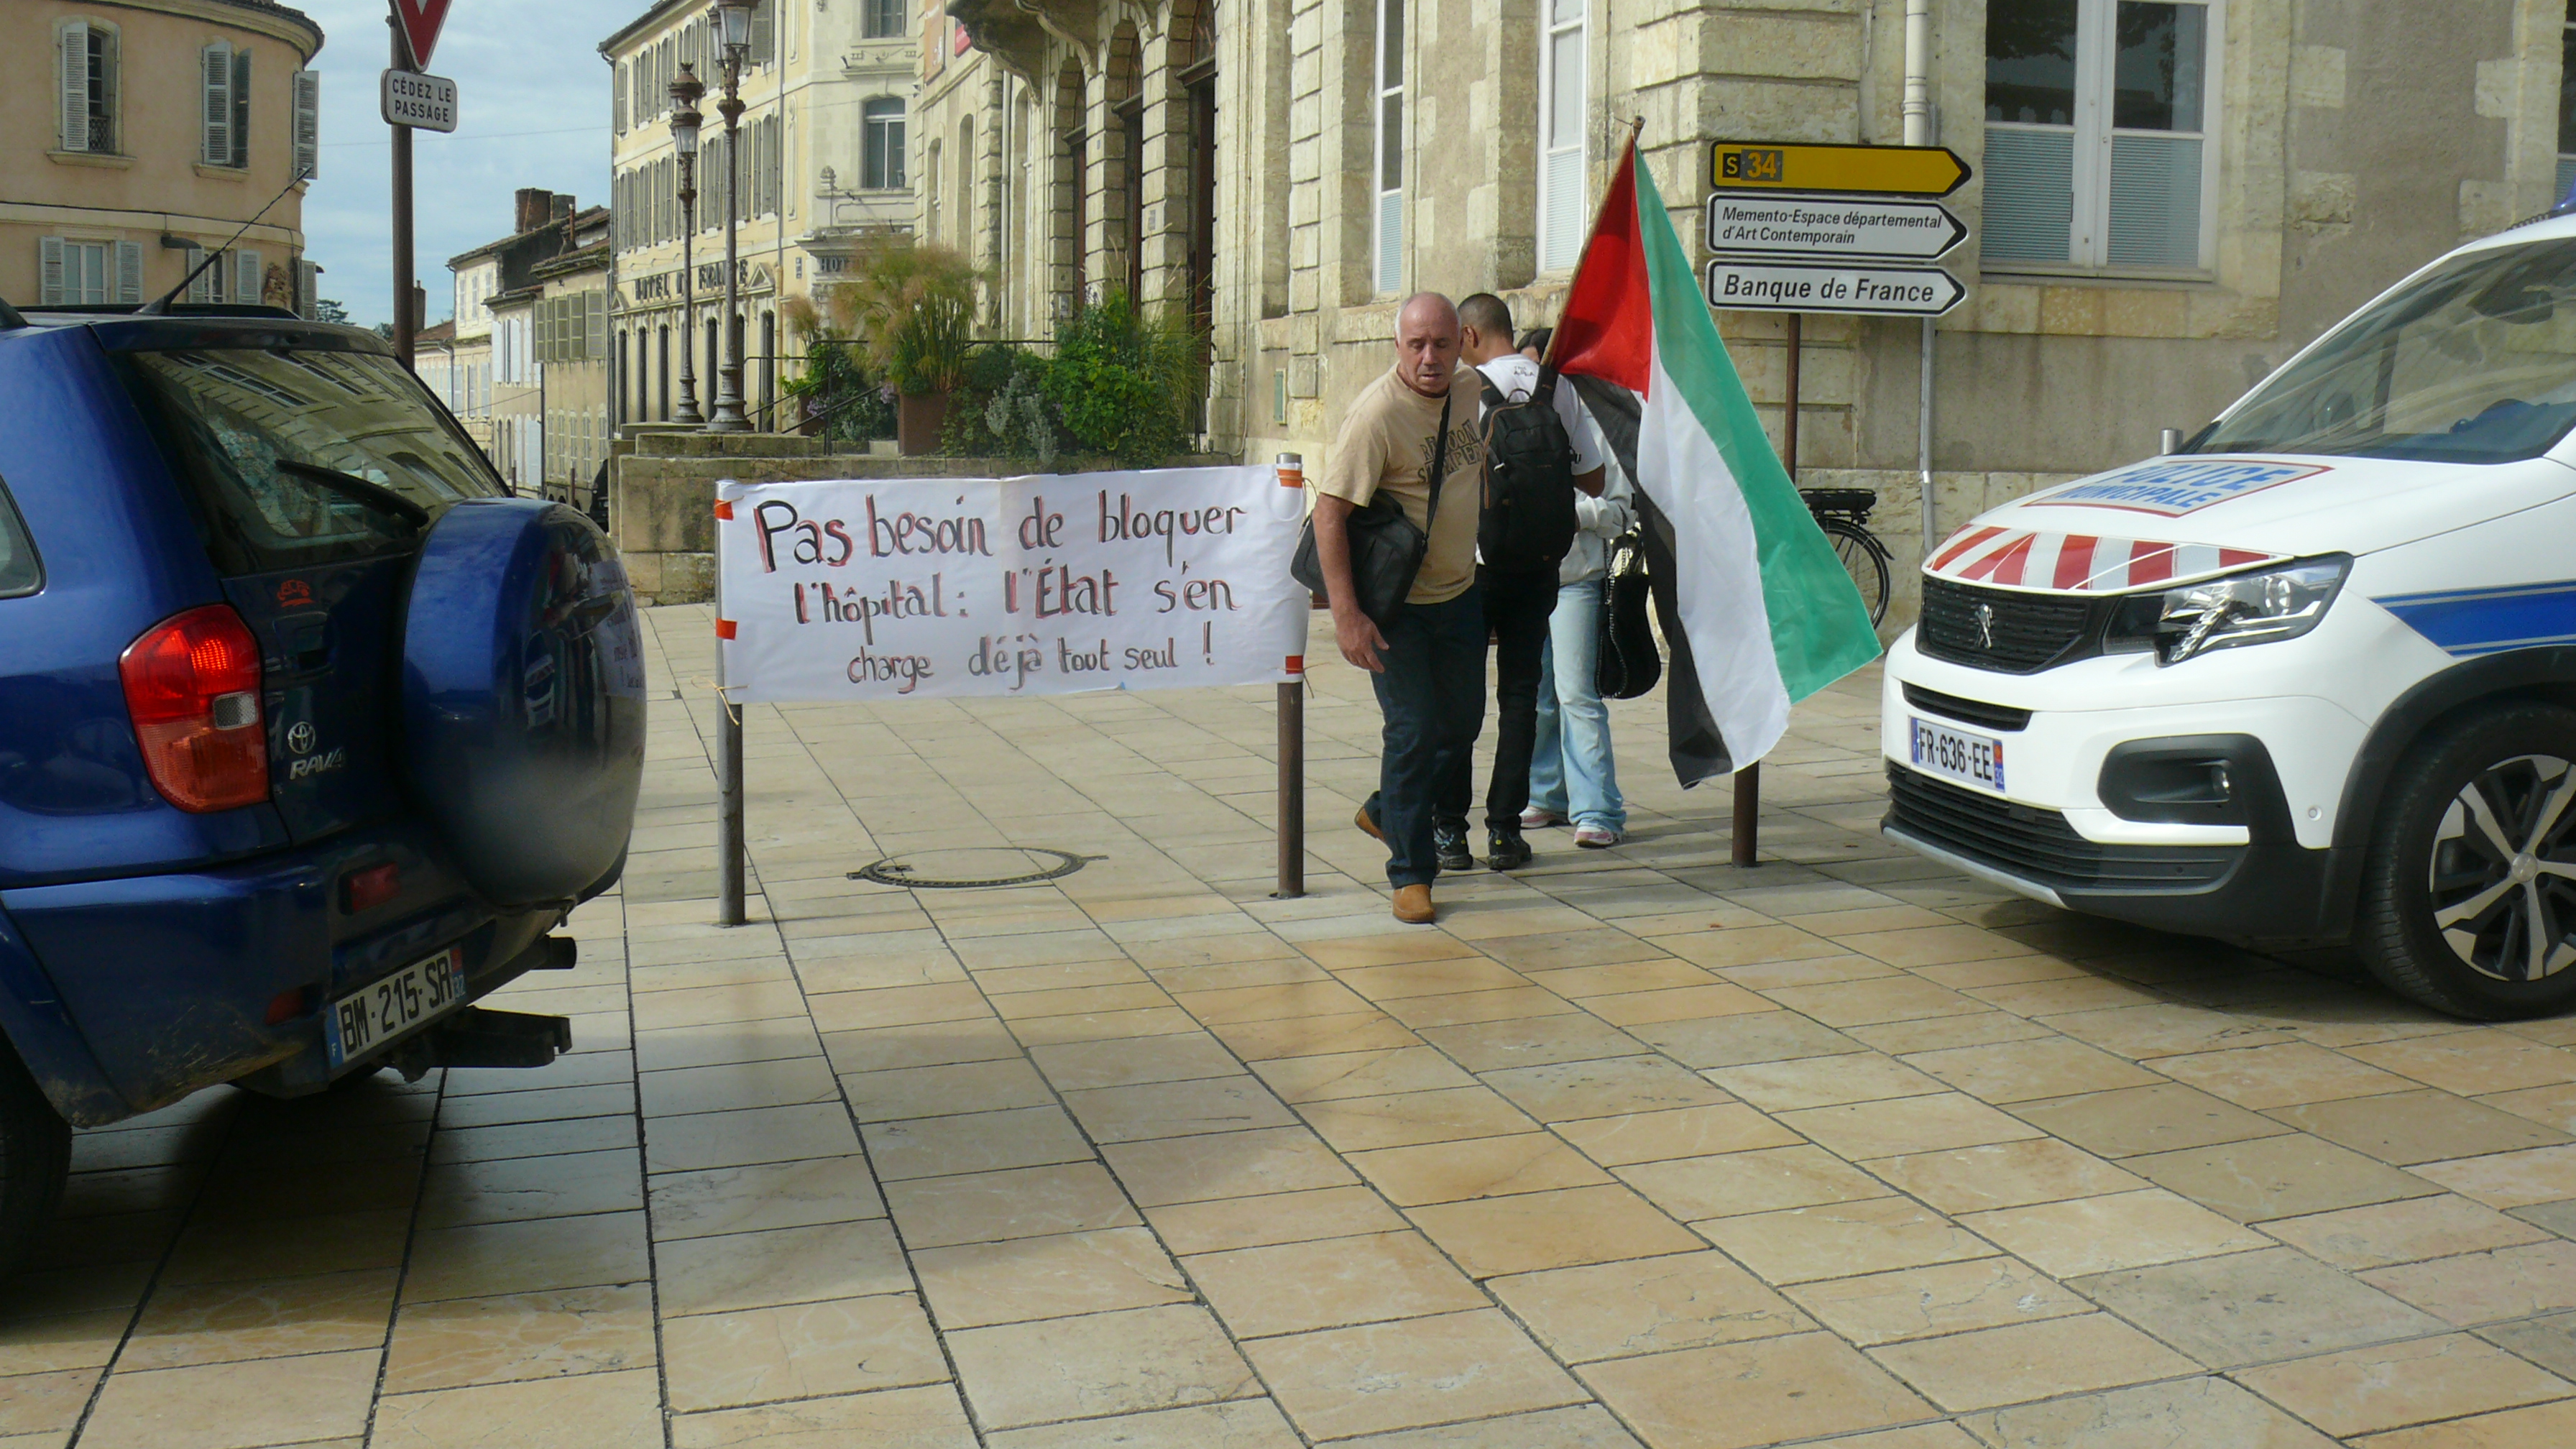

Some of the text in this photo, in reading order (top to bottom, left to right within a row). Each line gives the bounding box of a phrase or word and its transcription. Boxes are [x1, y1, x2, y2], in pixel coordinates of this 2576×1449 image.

[392, 77, 451, 103] CÉDEZ LE
[395, 100, 448, 123] PASSAGE
[1726, 152, 1776, 178] S 34
[1722, 206, 1942, 229] Memento-Espace départemental
[1722, 226, 1855, 246] d'Art Contemporain
[1724, 274, 1934, 303] Banque de France
[2095, 464, 2298, 492] POLICE
[2054, 485, 2223, 508] MUNICIPALE
[753, 489, 1248, 574] Pas besoin de bloquer
[847, 645, 934, 694] charge
[967, 632, 1042, 692] déjà
[1057, 637, 1110, 673] tout
[1123, 637, 1179, 671] seul
[289, 747, 344, 781] RAV4
[1919, 727, 1992, 782] FR-636-EE
[1995, 767, 2004, 786] 32
[454, 975, 466, 998] 32
